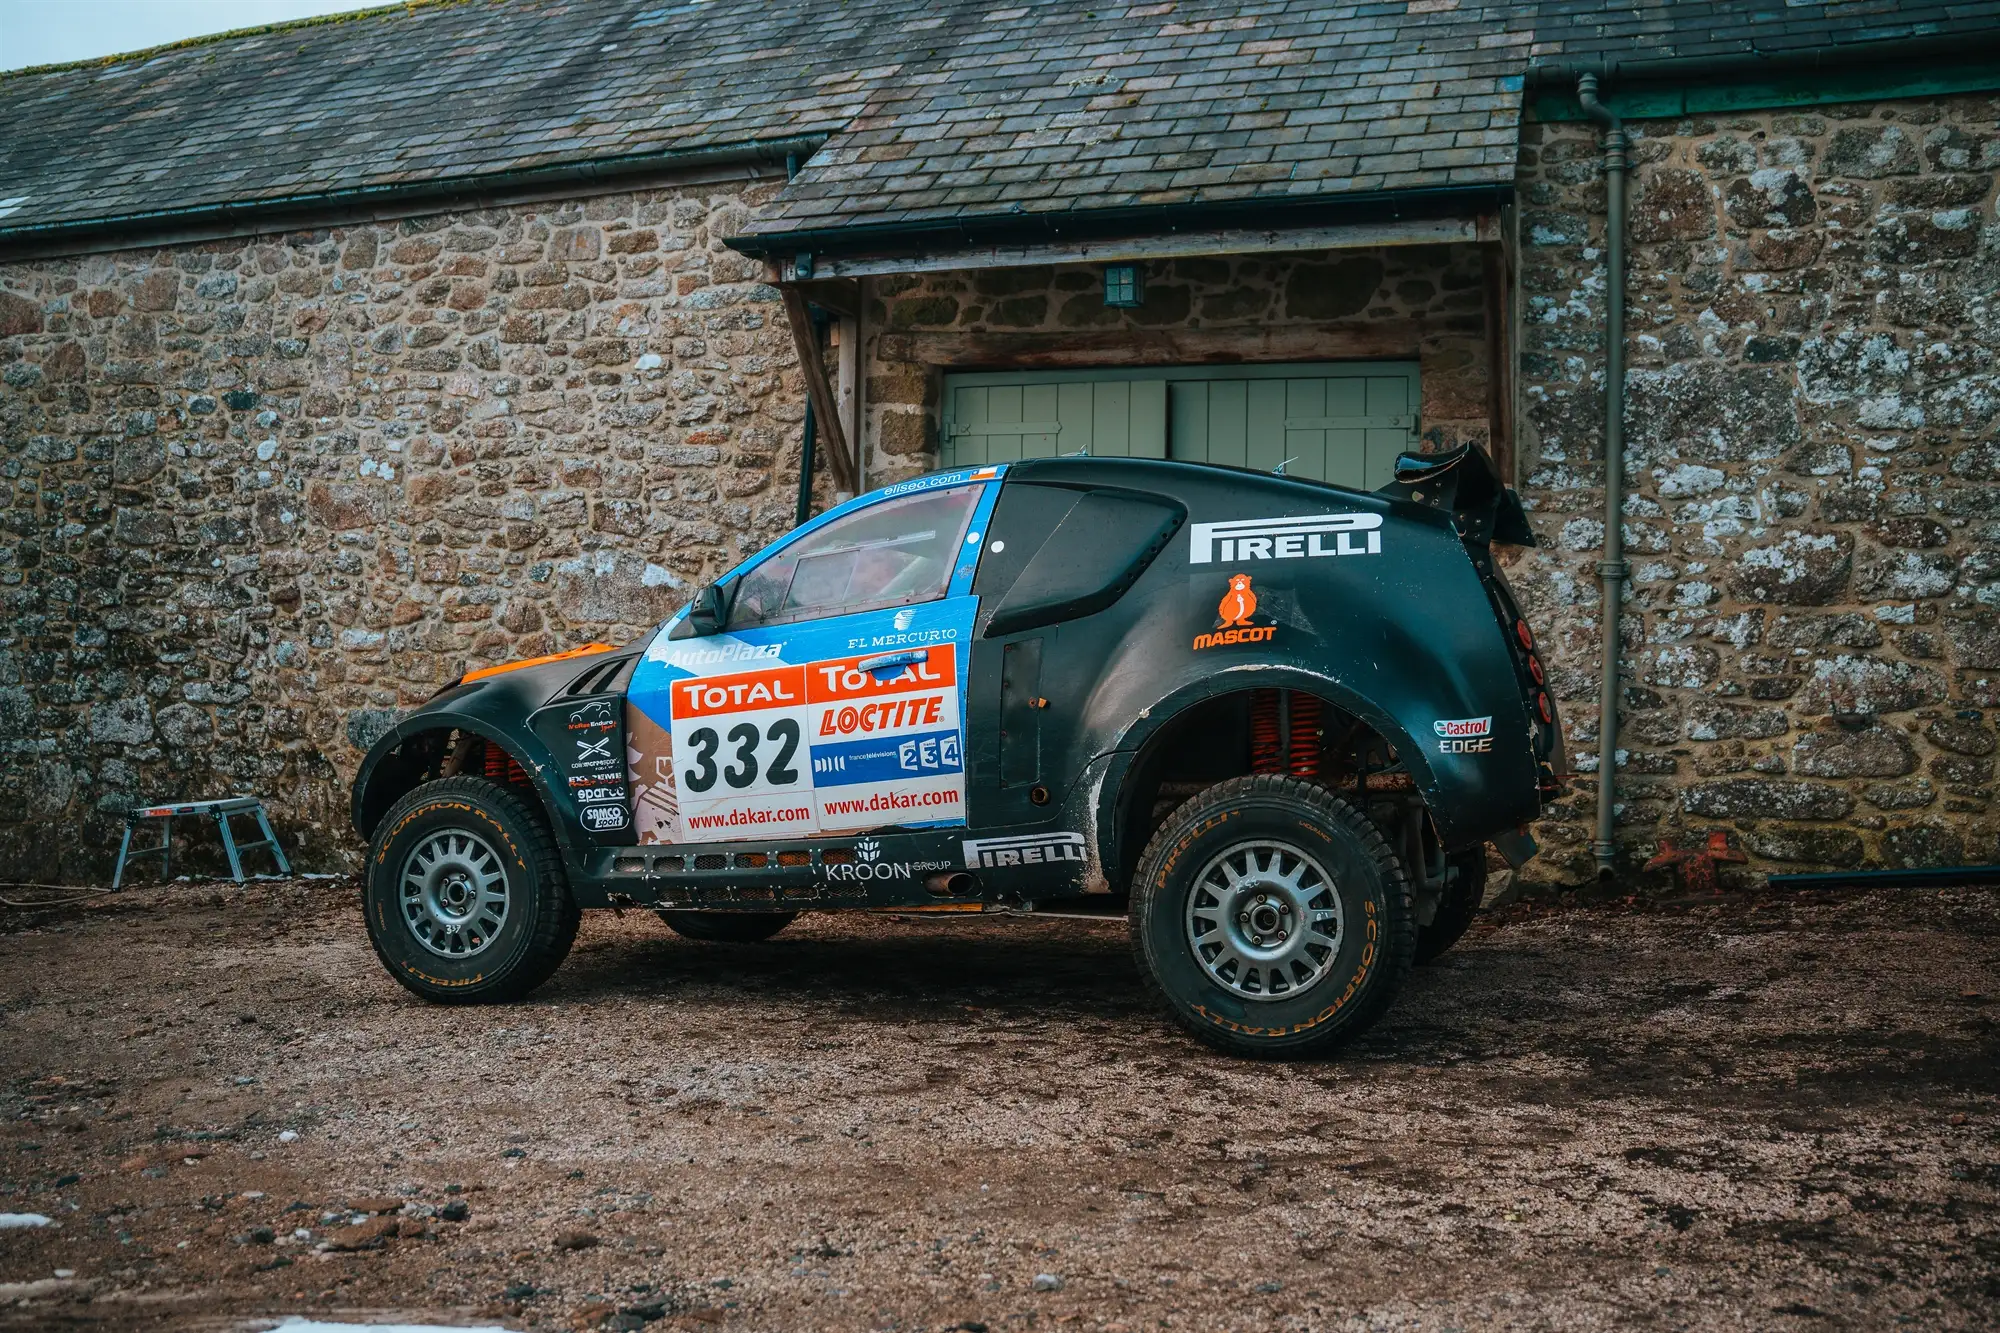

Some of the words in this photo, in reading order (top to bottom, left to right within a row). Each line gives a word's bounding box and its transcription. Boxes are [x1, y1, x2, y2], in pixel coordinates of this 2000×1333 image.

[884, 474, 961, 496] eliseo.com
[1190, 512, 1384, 564] PIRELLI
[848, 638, 869, 649] EL
[871, 628, 957, 648] MERCURIO
[1192, 626, 1278, 651] MASCOT
[664, 643, 783, 668] AutoPlaza
[683, 680, 794, 711] TOTAL
[819, 695, 943, 736] LOCTITE
[1446, 719, 1487, 735] Castrol
[684, 718, 801, 793] 332
[904, 749, 917, 767] 2
[924, 746, 938, 764] 3
[944, 744, 959, 762] 4
[1438, 737, 1494, 753] EDGE
[586, 807, 621, 820] SAMCO
[824, 789, 959, 815] www.dakar.com
[597, 817, 621, 828] sport
[688, 804, 810, 830] www.dakar.com
[377, 801, 471, 865] SCORPION
[474, 810, 527, 870] RALLY
[962, 831, 1087, 869] PIRELLI
[1157, 810, 1230, 889] PIRELLI
[826, 862, 911, 881] KROON
[912, 861, 951, 872] GROUP
[407, 966, 484, 987] PIRELLI
[1294, 901, 1377, 1034] SCORPION
[1191, 1004, 1286, 1037] RALLY
